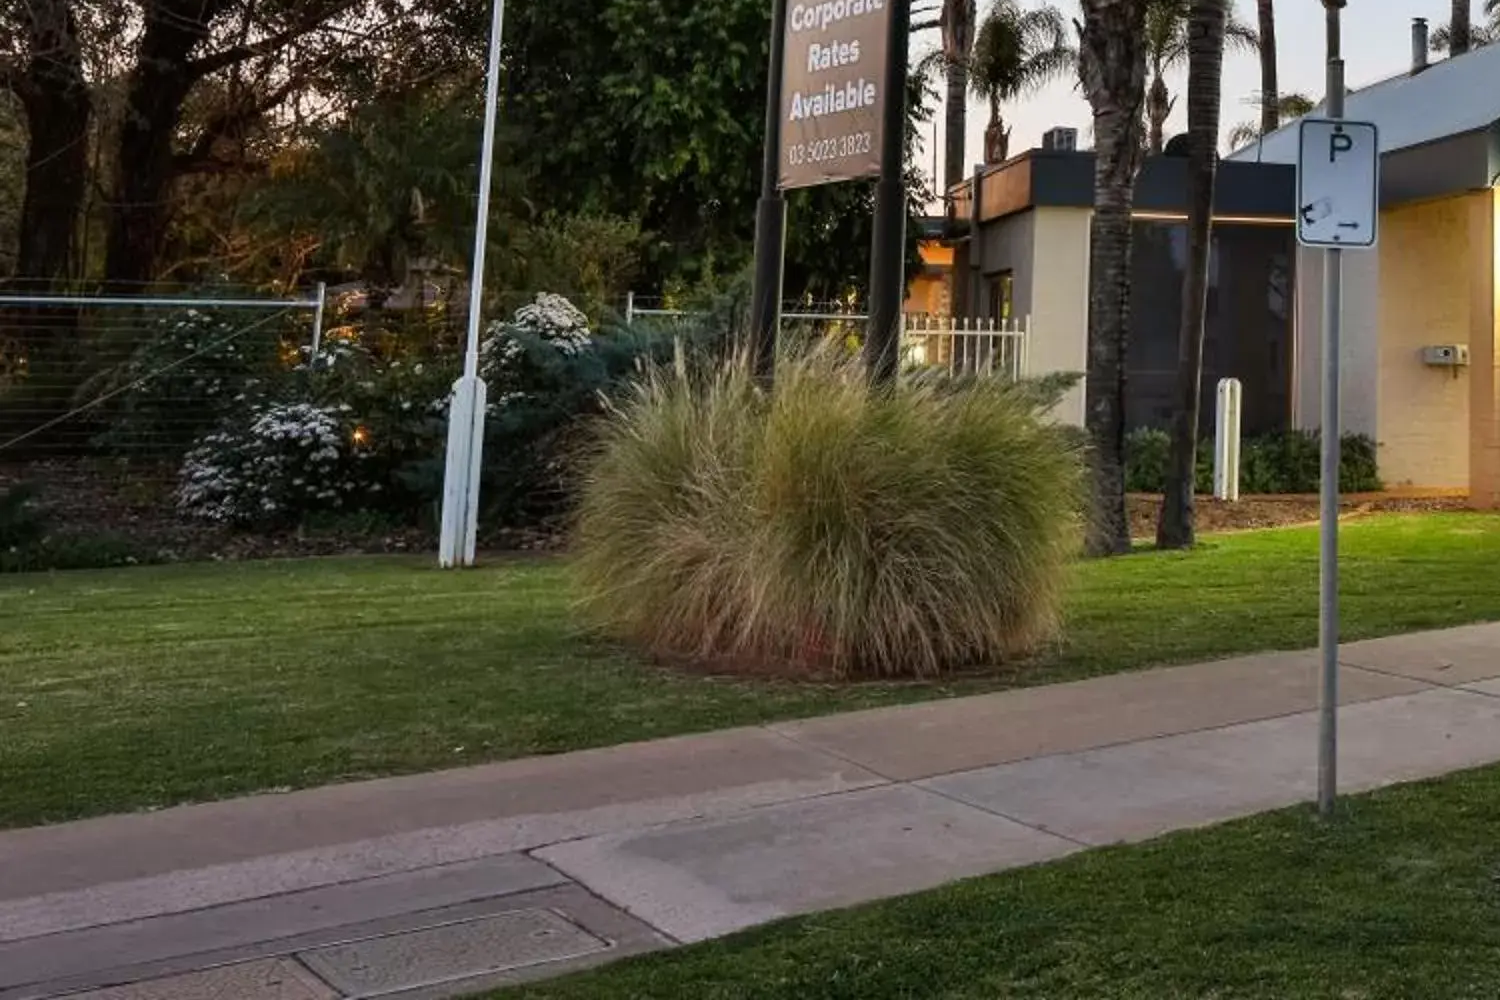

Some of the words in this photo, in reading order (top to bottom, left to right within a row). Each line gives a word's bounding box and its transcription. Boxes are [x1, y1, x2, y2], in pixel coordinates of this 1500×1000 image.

[808, 40, 860, 72] Rates
[790, 78, 875, 120] Available
[790, 144, 805, 165] 03
[840, 132, 871, 157] 3823
[1329, 133, 1352, 163] P
